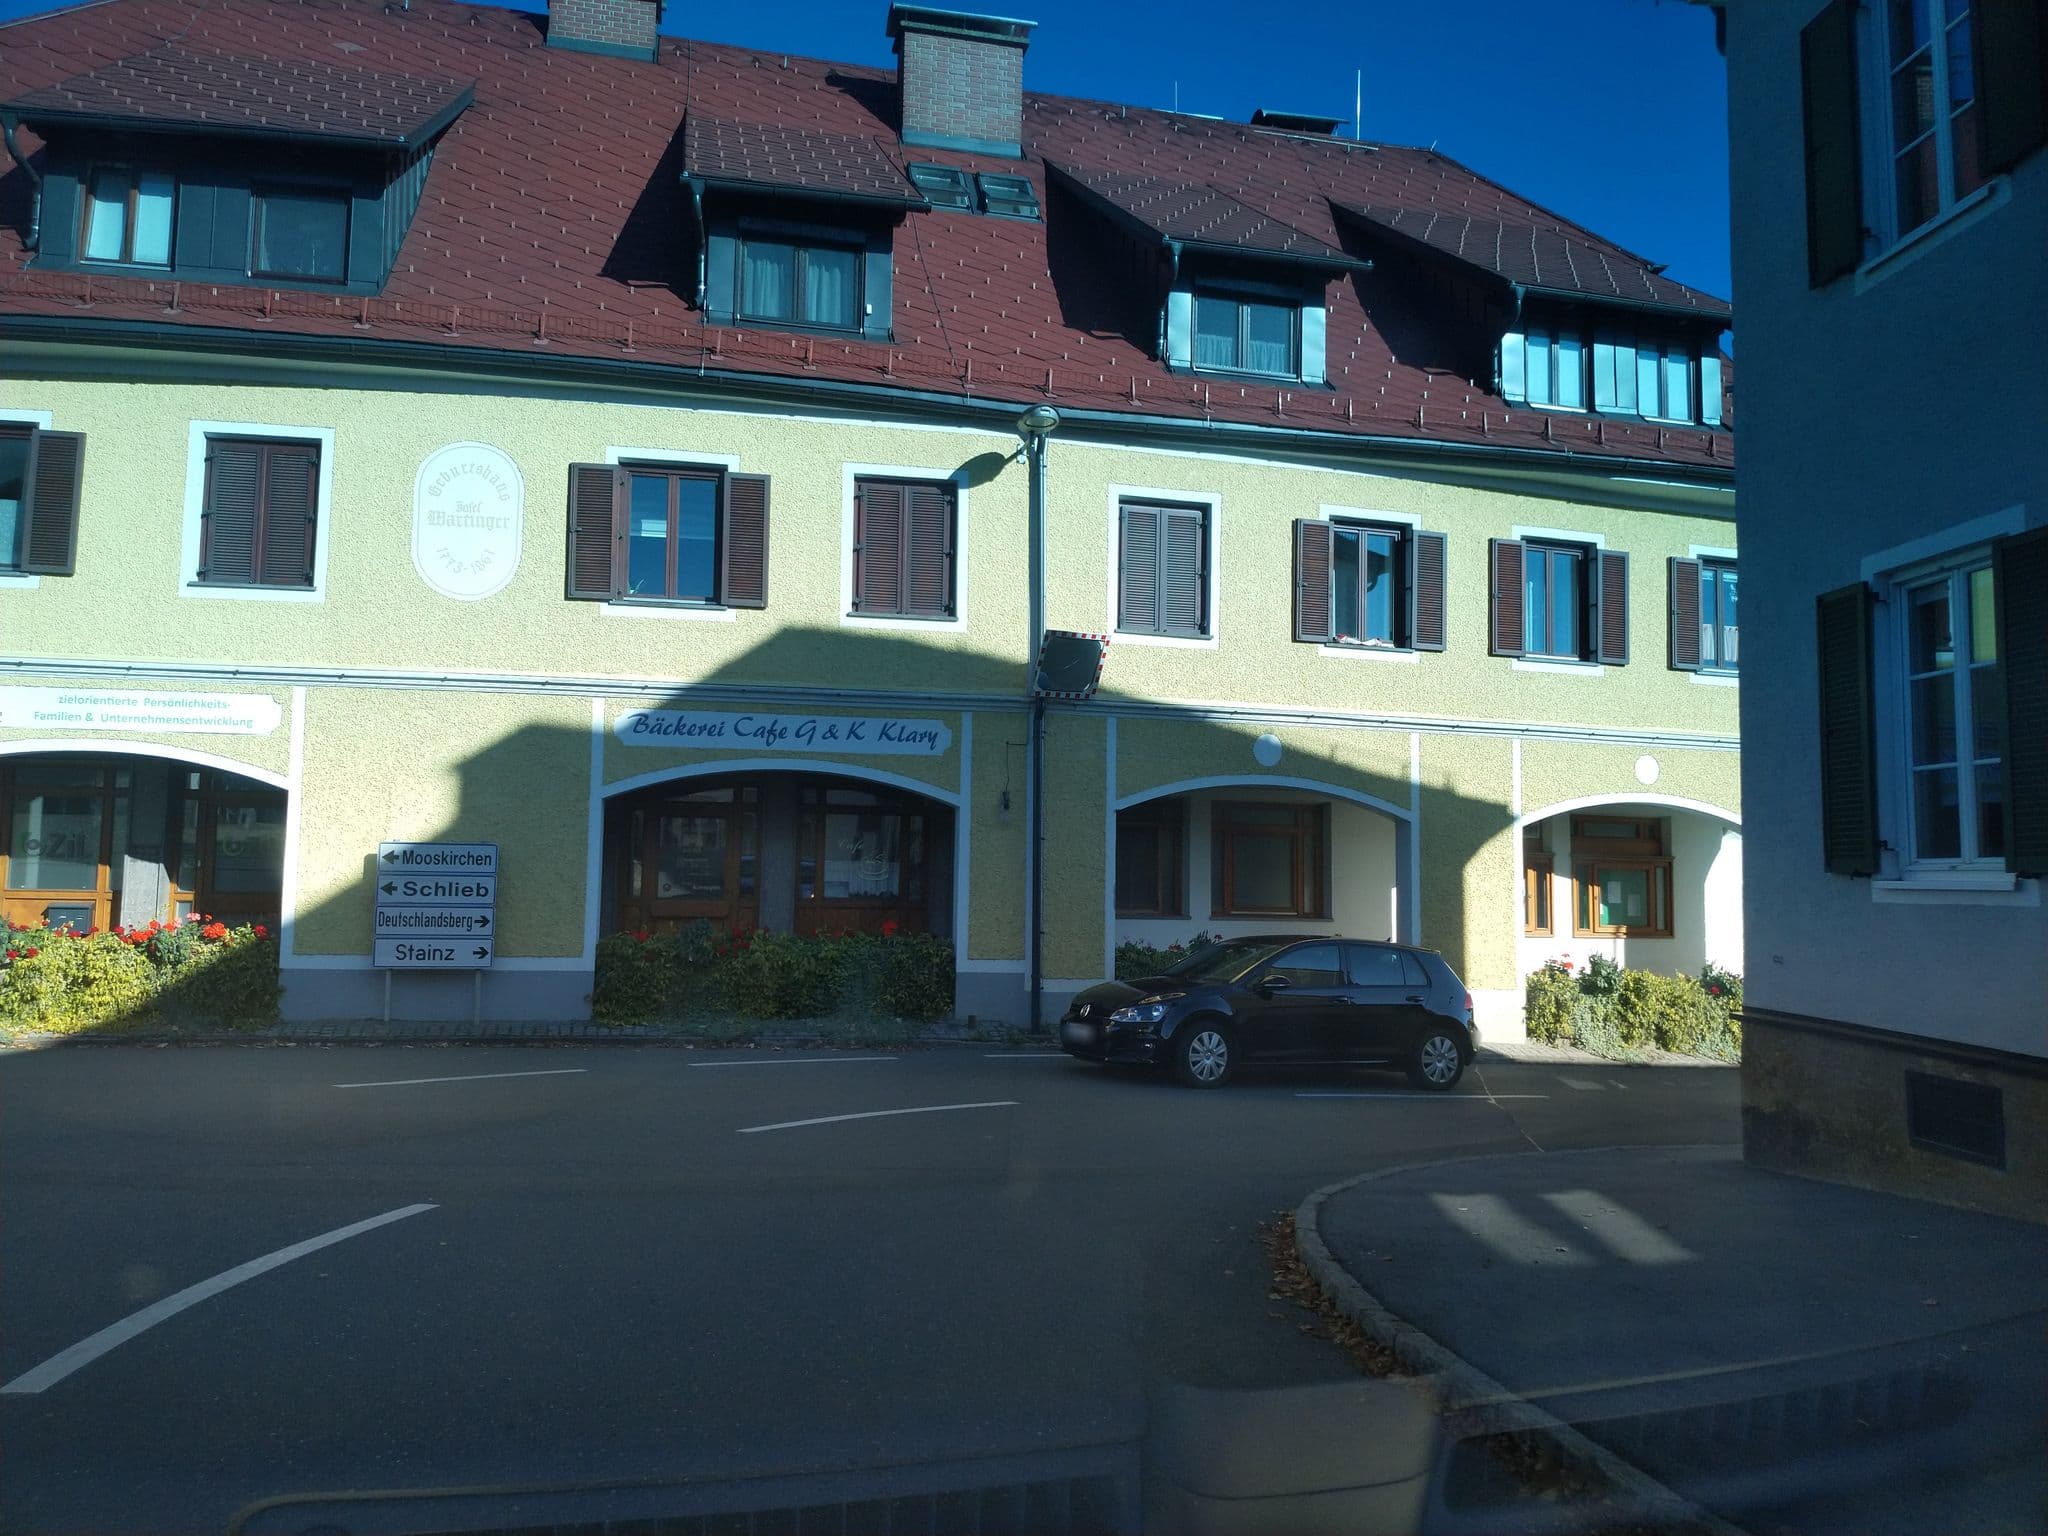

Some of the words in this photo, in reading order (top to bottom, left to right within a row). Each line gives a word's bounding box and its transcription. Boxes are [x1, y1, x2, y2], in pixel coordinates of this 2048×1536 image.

[58, 695, 138, 707] zielorientierte
[143, 697, 231, 710] Persönlichkeits-
[34, 711, 82, 722] Familien
[85, 712, 95, 722] &
[101, 712, 253, 729] Unternehmensentwicklung
[628, 713, 725, 737] Bäckerei
[733, 716, 788, 747] Cafe
[823, 720, 839, 738] &
[845, 721, 866, 741] K
[877, 721, 938, 750] Klary
[402, 850, 492, 866] Mooskirchen
[402, 881, 490, 898] Schlieb
[378, 911, 473, 932] Deutschlandsberg
[396, 943, 455, 961] Stainz
